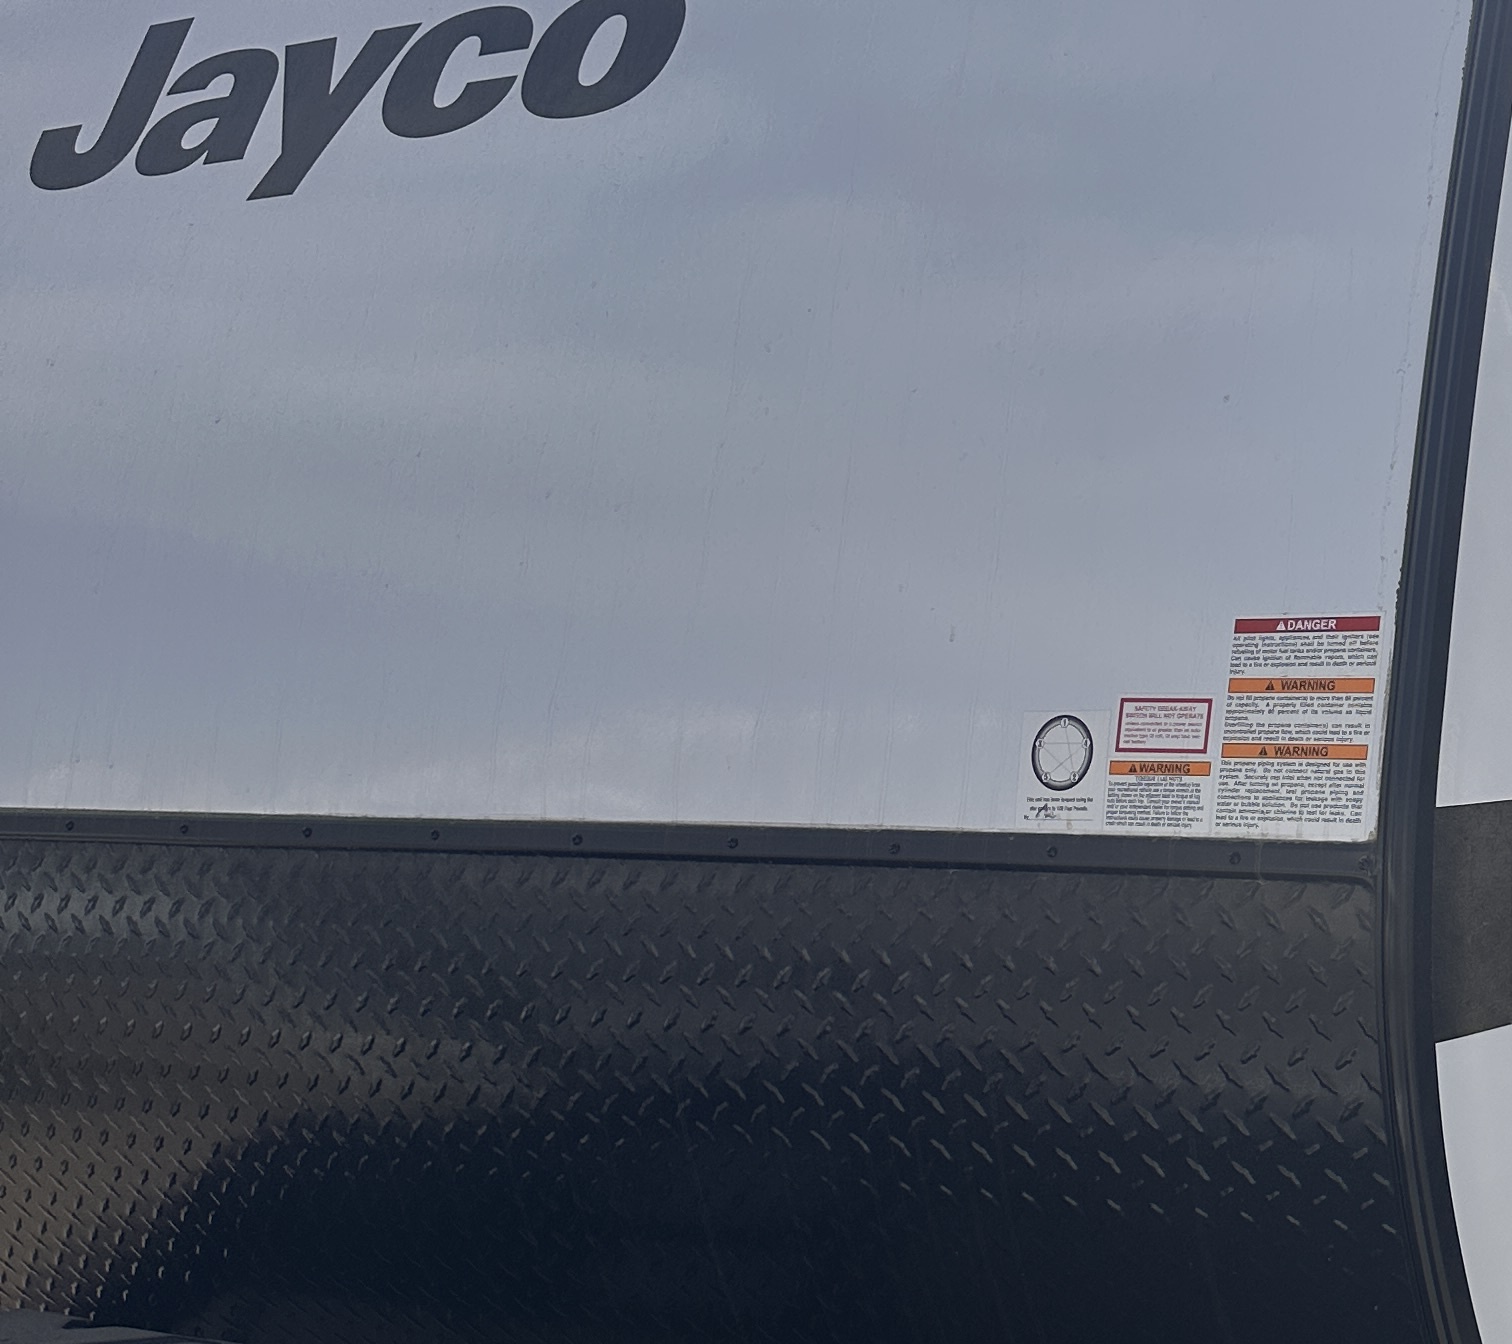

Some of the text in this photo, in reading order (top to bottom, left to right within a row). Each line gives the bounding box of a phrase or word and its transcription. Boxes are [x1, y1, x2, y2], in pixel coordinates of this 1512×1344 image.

[1287, 619, 1337, 631] DANGER
[1281, 680, 1336, 691] WARNING
[1274, 746, 1329, 757] WARNING
[1140, 764, 1191, 774] WARNING
